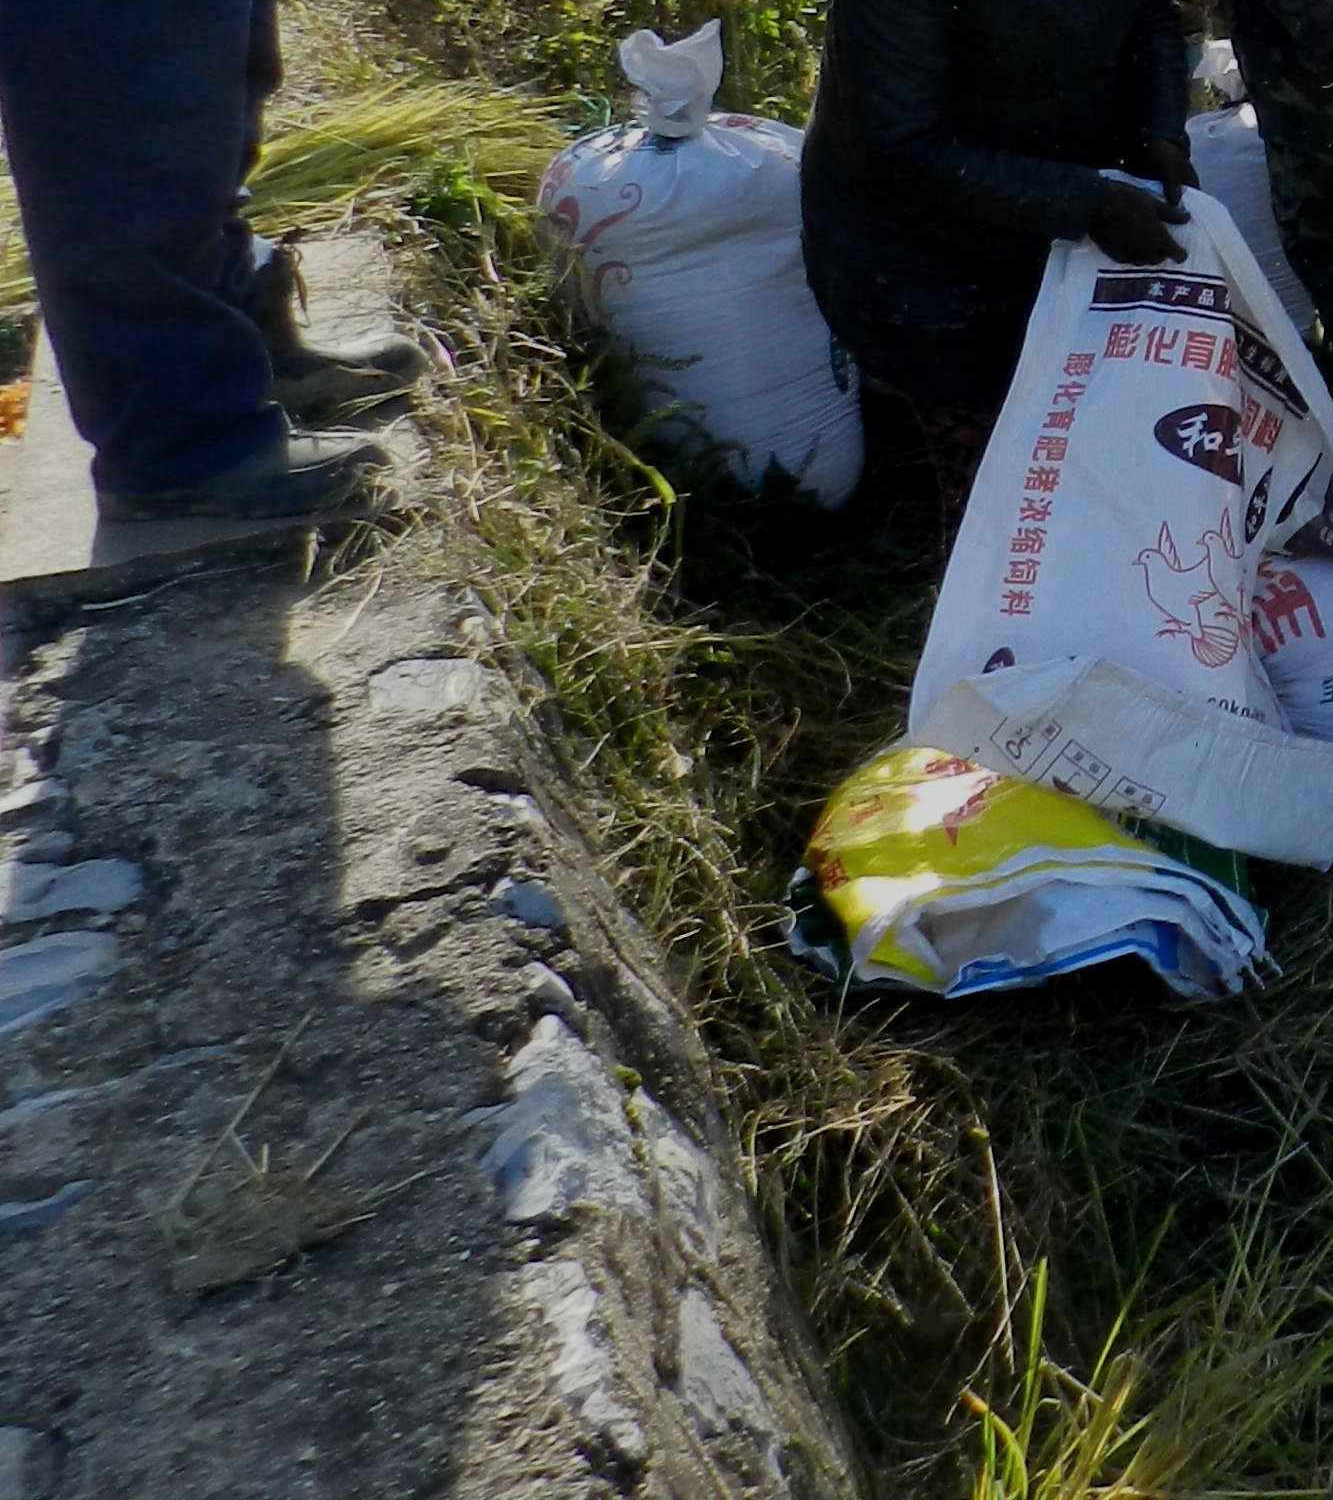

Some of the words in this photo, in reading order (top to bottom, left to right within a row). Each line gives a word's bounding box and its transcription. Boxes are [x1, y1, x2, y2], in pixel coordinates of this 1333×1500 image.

[999, 352, 1097, 618] 膨化育肥猪浓缩饲料
